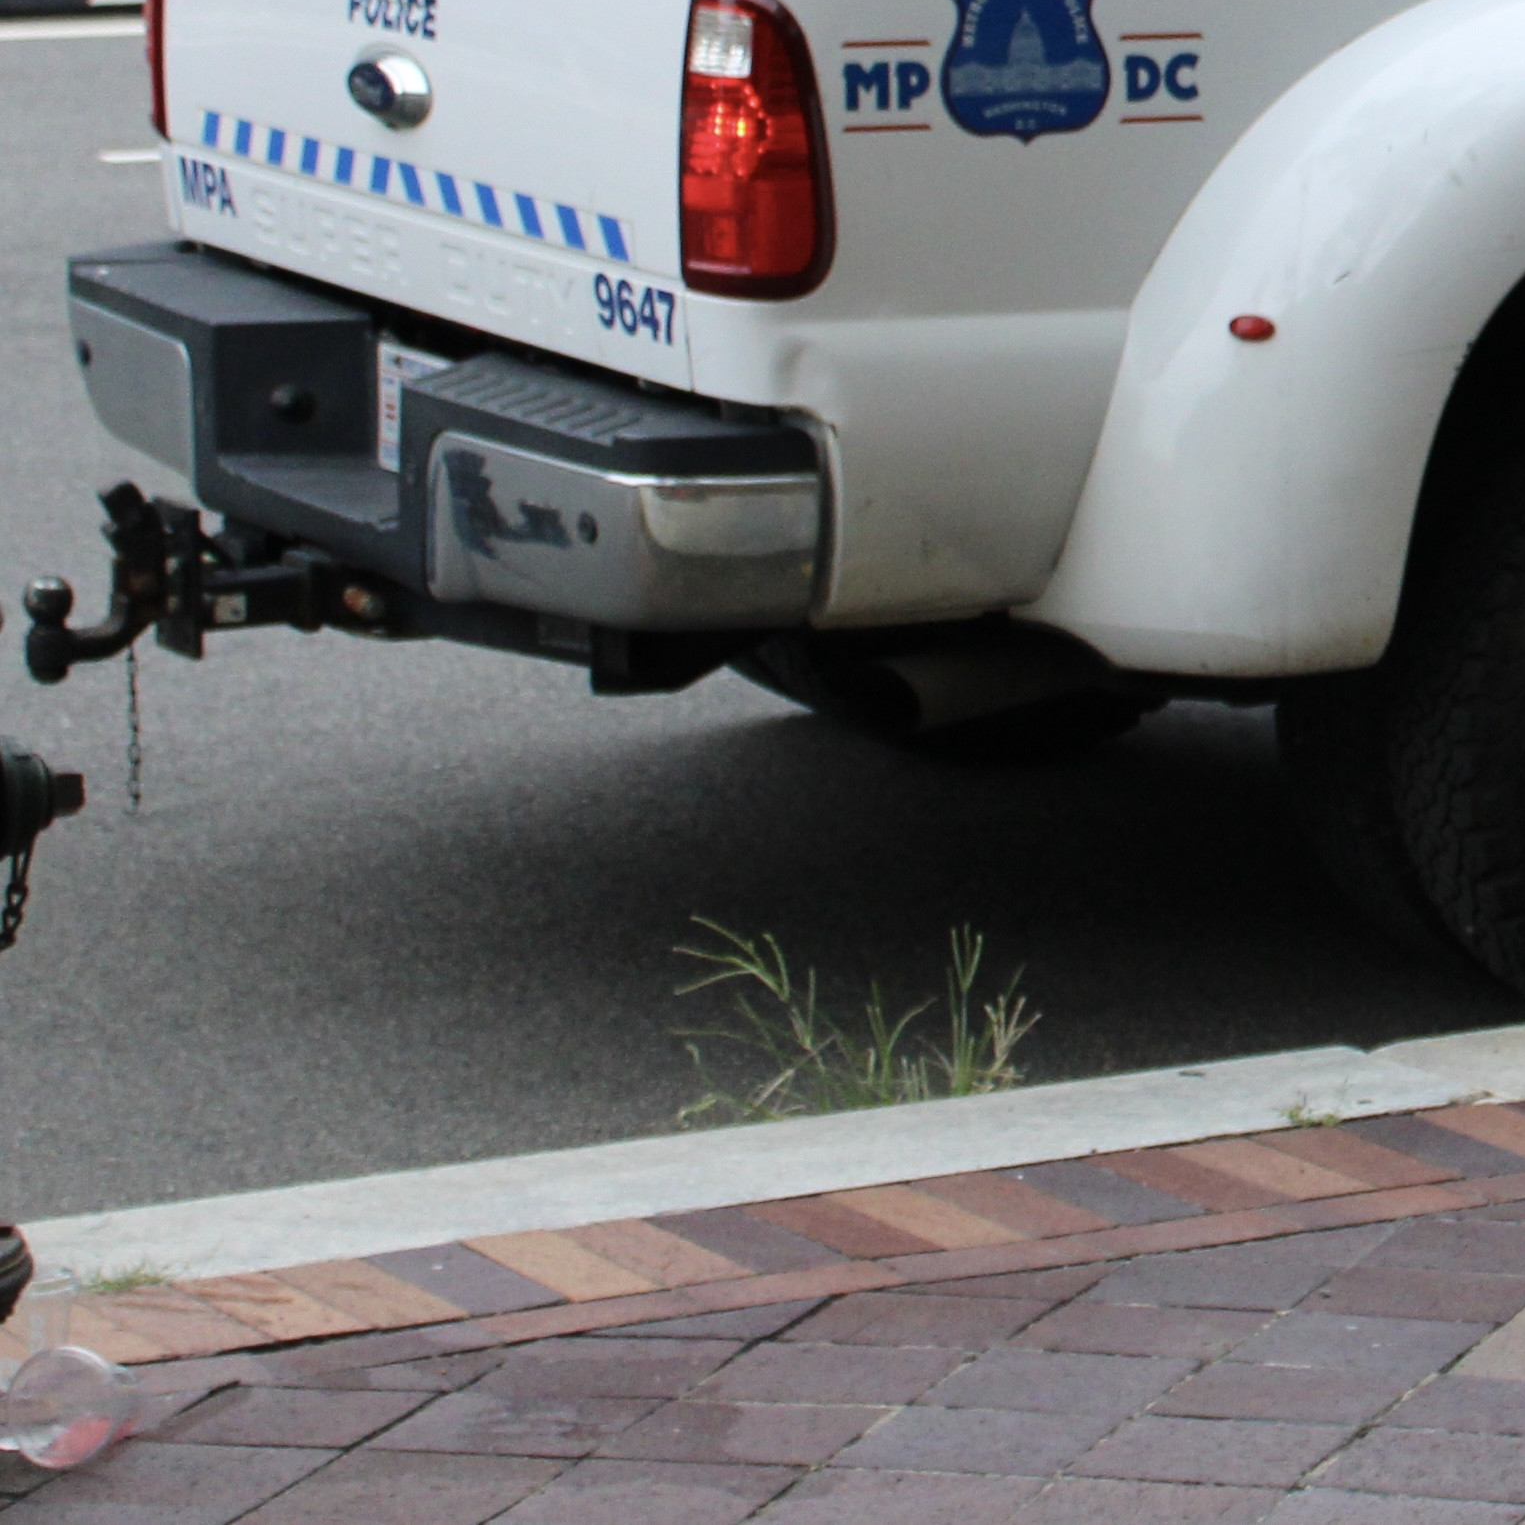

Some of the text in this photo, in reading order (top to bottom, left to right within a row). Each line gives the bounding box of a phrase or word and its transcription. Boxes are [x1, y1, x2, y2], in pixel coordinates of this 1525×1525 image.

[842, 60, 931, 111] MP
[1122, 52, 1200, 104] DC
[179, 156, 238, 217] MPA
[252, 186, 578, 337] SUPER DUTY
[594, 273, 677, 347] 9647
